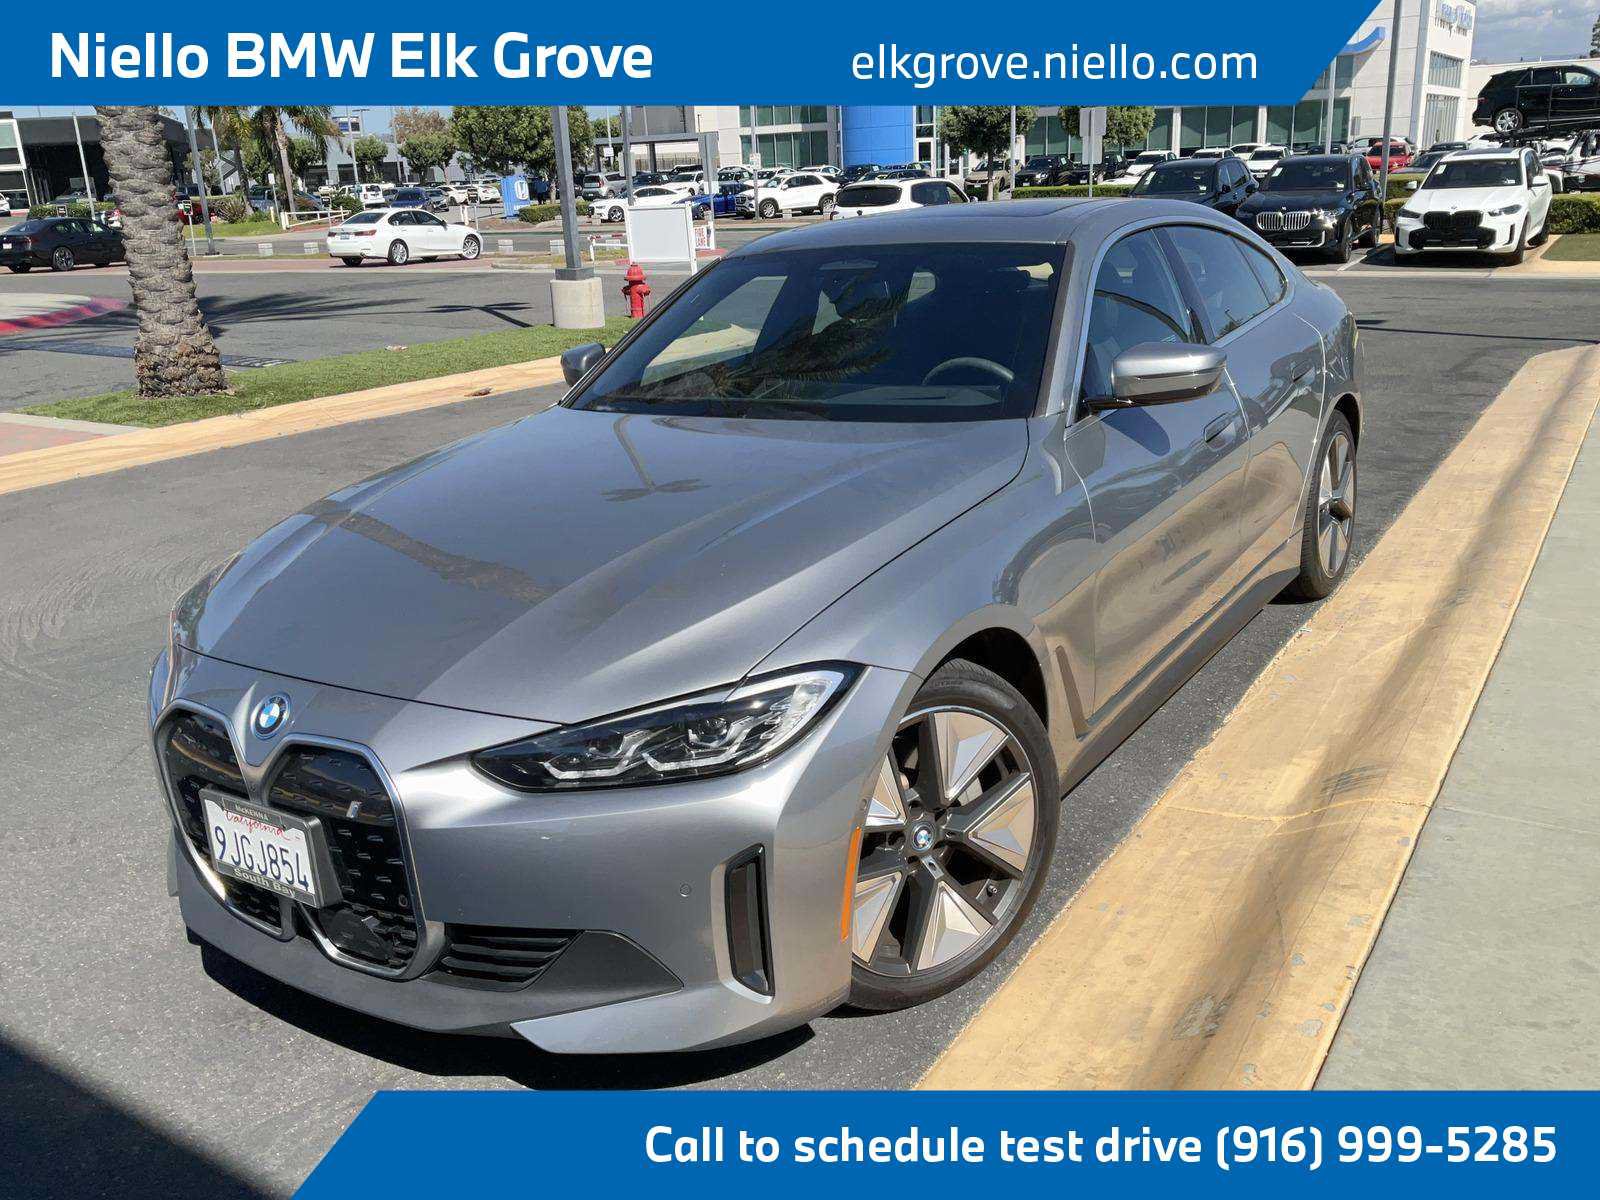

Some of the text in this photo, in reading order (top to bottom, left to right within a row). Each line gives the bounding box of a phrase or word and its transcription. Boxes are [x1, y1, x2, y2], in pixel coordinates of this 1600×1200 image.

[215, 825, 309, 892] 9JGJ854
[233, 868, 296, 899] South Bay
